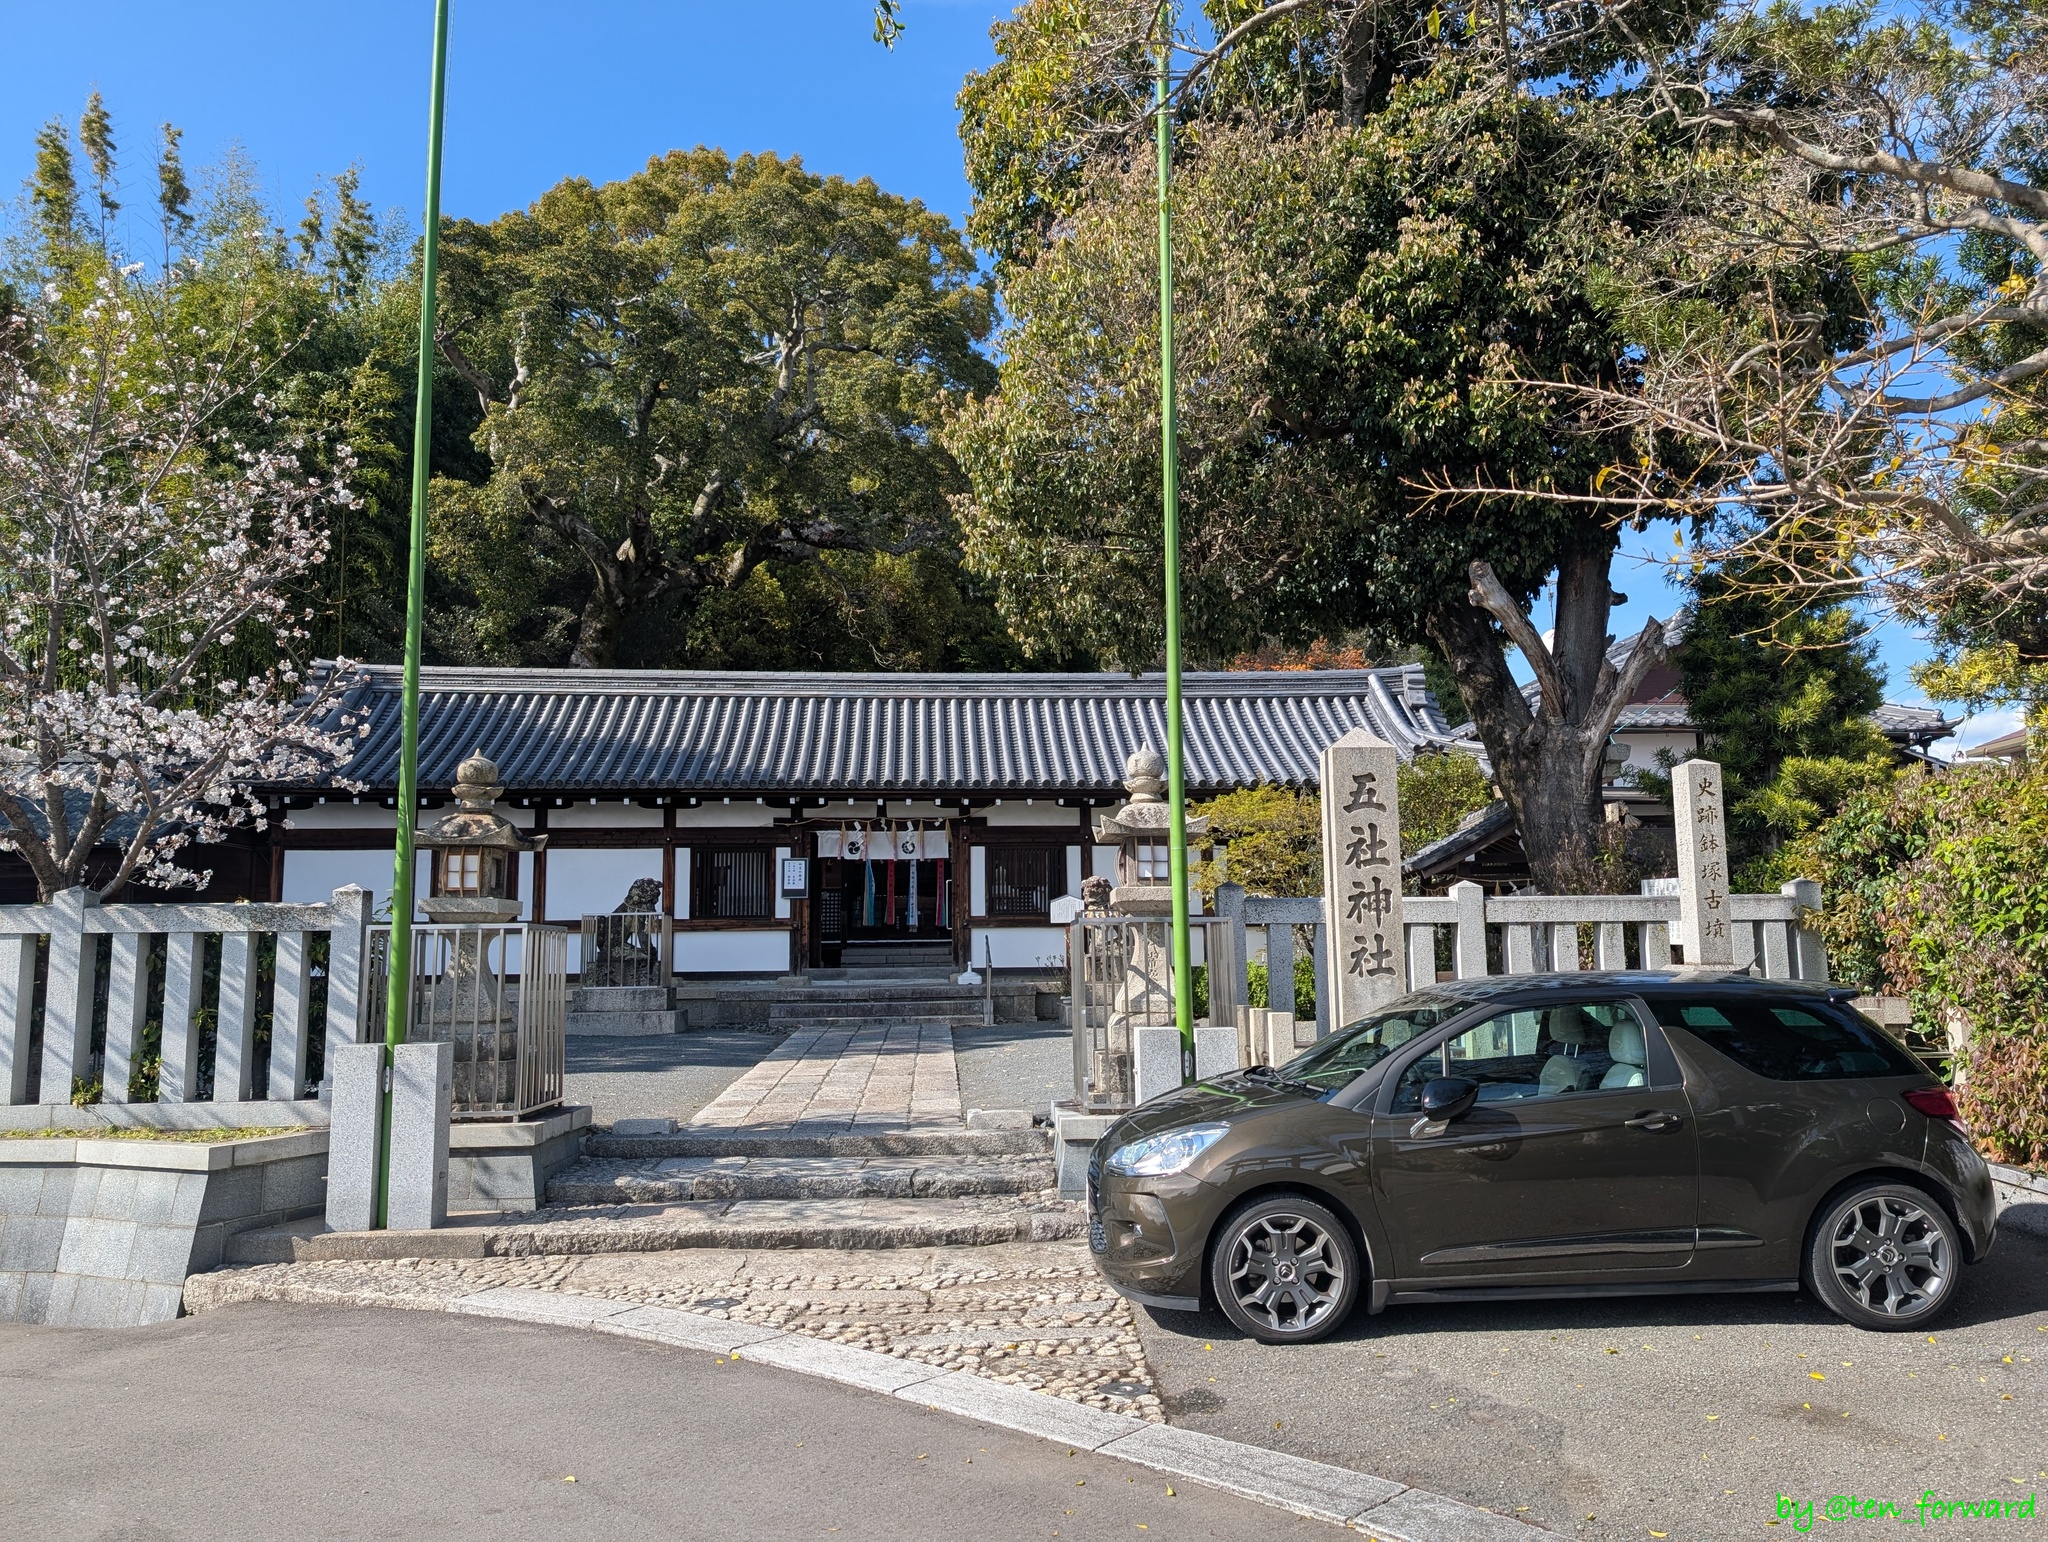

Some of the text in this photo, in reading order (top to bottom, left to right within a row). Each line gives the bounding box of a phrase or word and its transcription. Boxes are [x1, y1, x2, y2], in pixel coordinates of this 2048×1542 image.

[1342, 771, 1397, 979] 五社神社
[1696, 777, 1725, 939] 史跡鉢塚古墳
